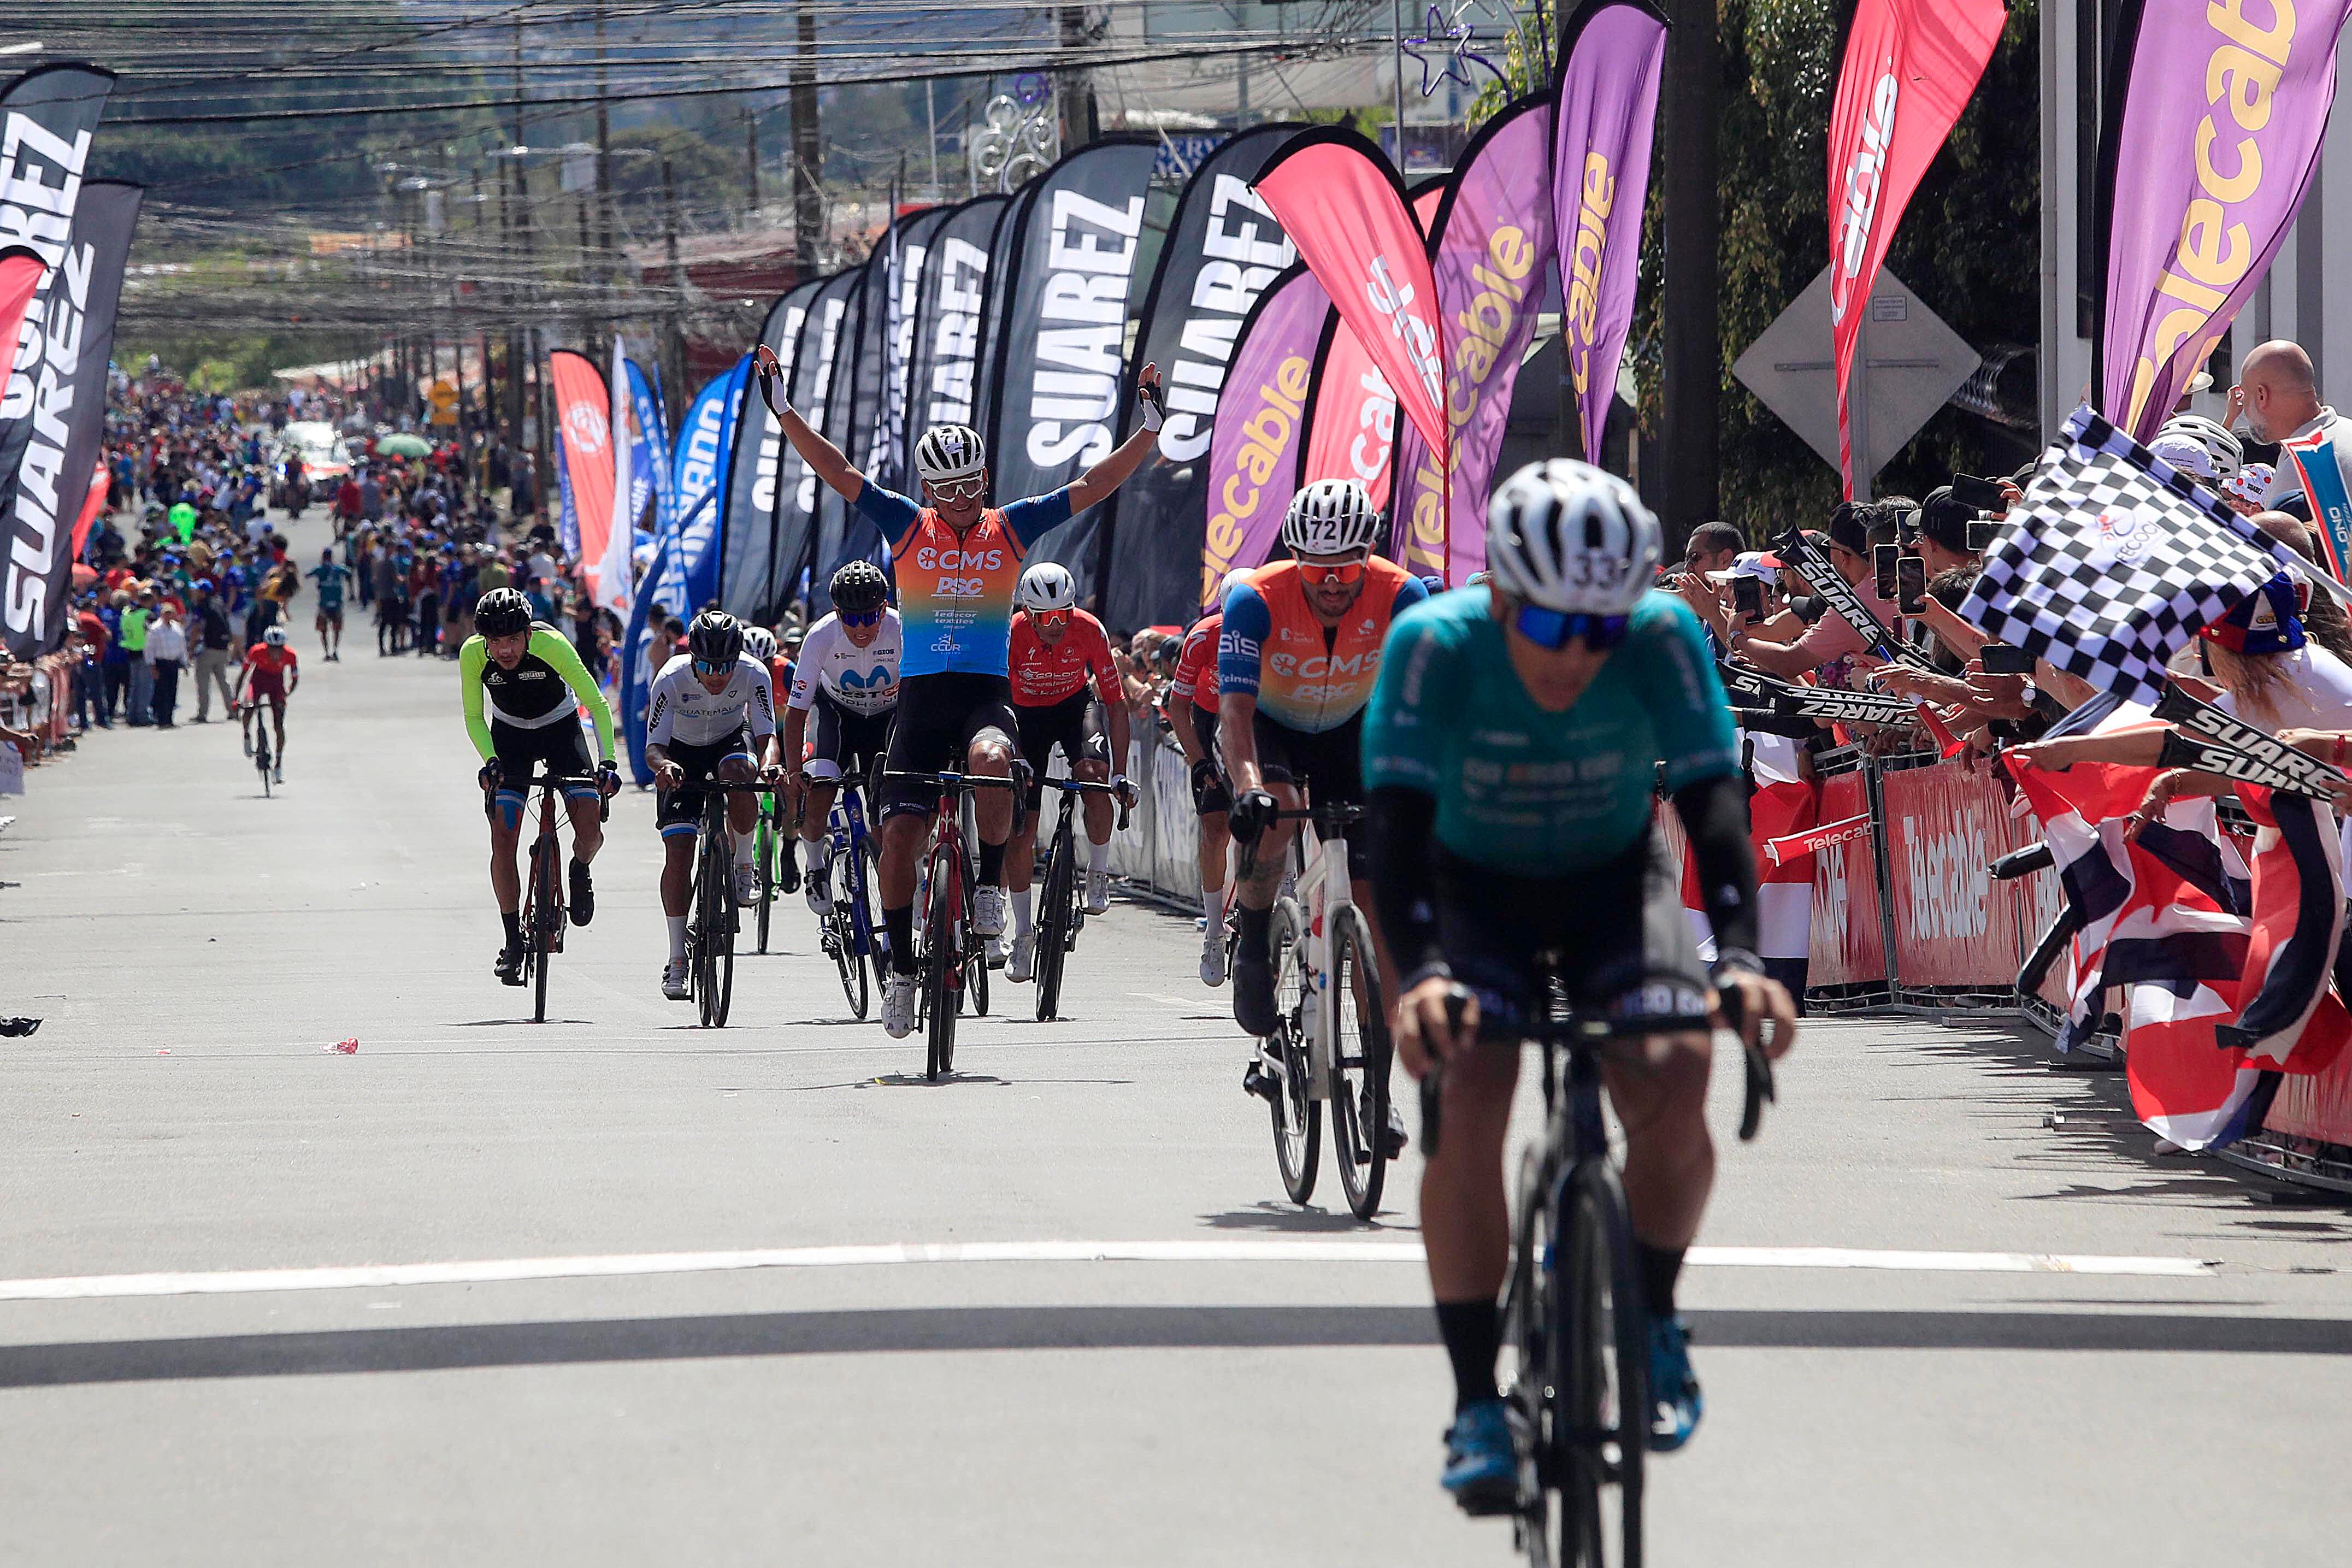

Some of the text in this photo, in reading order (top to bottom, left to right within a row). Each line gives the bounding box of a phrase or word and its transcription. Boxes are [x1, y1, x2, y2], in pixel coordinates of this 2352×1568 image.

[1027, 189, 1145, 468] SUAREZ
[5, 242, 95, 642] SUAREZ
[1311, 521, 1336, 540] 72
[936, 577, 983, 595] PSC
[1794, 562, 1879, 645] SUARE
[2185, 709, 2347, 797] SUARE
[1803, 822, 1871, 852] Teleca
